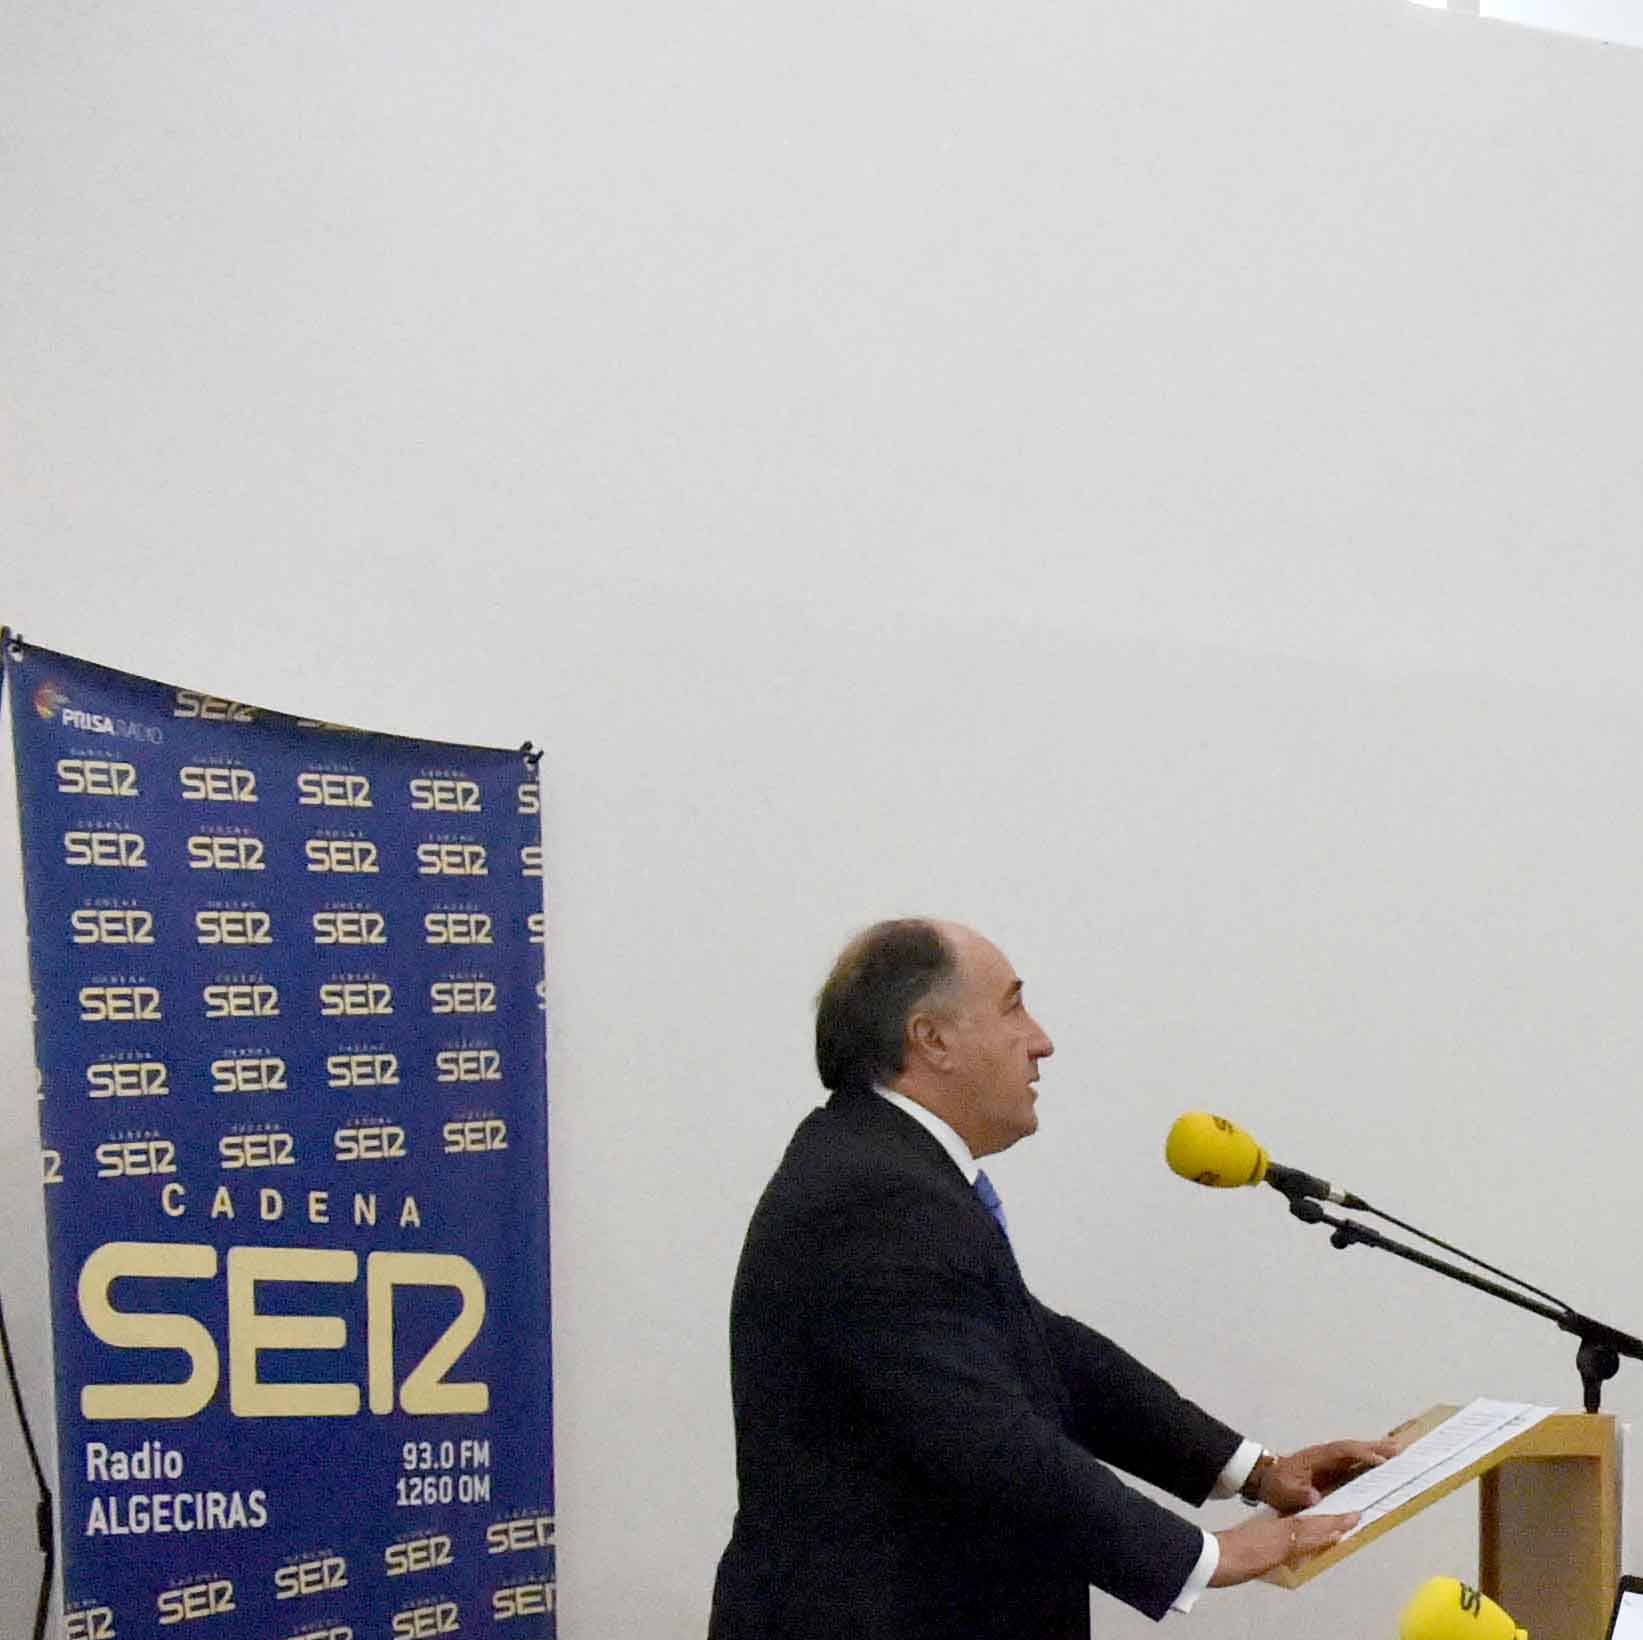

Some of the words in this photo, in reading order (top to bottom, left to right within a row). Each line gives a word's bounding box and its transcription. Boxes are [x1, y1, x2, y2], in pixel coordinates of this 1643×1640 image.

[57, 759, 138, 796] SER
[180, 766, 258, 802] SER
[297, 772, 372, 807] SER
[409, 779, 481, 812] SER
[64, 831, 148, 867] SER
[187, 836, 266, 870] SER
[305, 839, 379, 873] SER
[417, 843, 488, 875] SER
[71, 909, 155, 944] SER
[195, 910, 273, 944] SER
[312, 912, 387, 944] SER
[424, 913, 493, 944] SER
[79, 986, 162, 1021] SER
[203, 984, 280, 1017] SER
[319, 983, 393, 1016] SER
[430, 981, 497, 1013] SER
[86, 1062, 169, 1098] SER
[210, 1057, 287, 1092] SER
[326, 1053, 400, 1087] SER
[436, 1049, 502, 1082] SER
[219, 1133, 295, 1168] SER
[334, 1126, 407, 1161] SER
[443, 1119, 508, 1153] SER
[96, 1140, 177, 1177] SER
[161, 1183, 420, 1227] CADENA
[78, 1242, 489, 1420] SER
[87, 1441, 183, 1481] Radio
[403, 1441, 454, 1470] 93.0
[460, 1440, 490, 1469] FM
[396, 1475, 453, 1506] 1260
[86, 1489, 268, 1536] ALGECIRAS
[385, 1535, 453, 1576] SER
[274, 1556, 348, 1599] SER
[157, 1580, 236, 1624] SER
